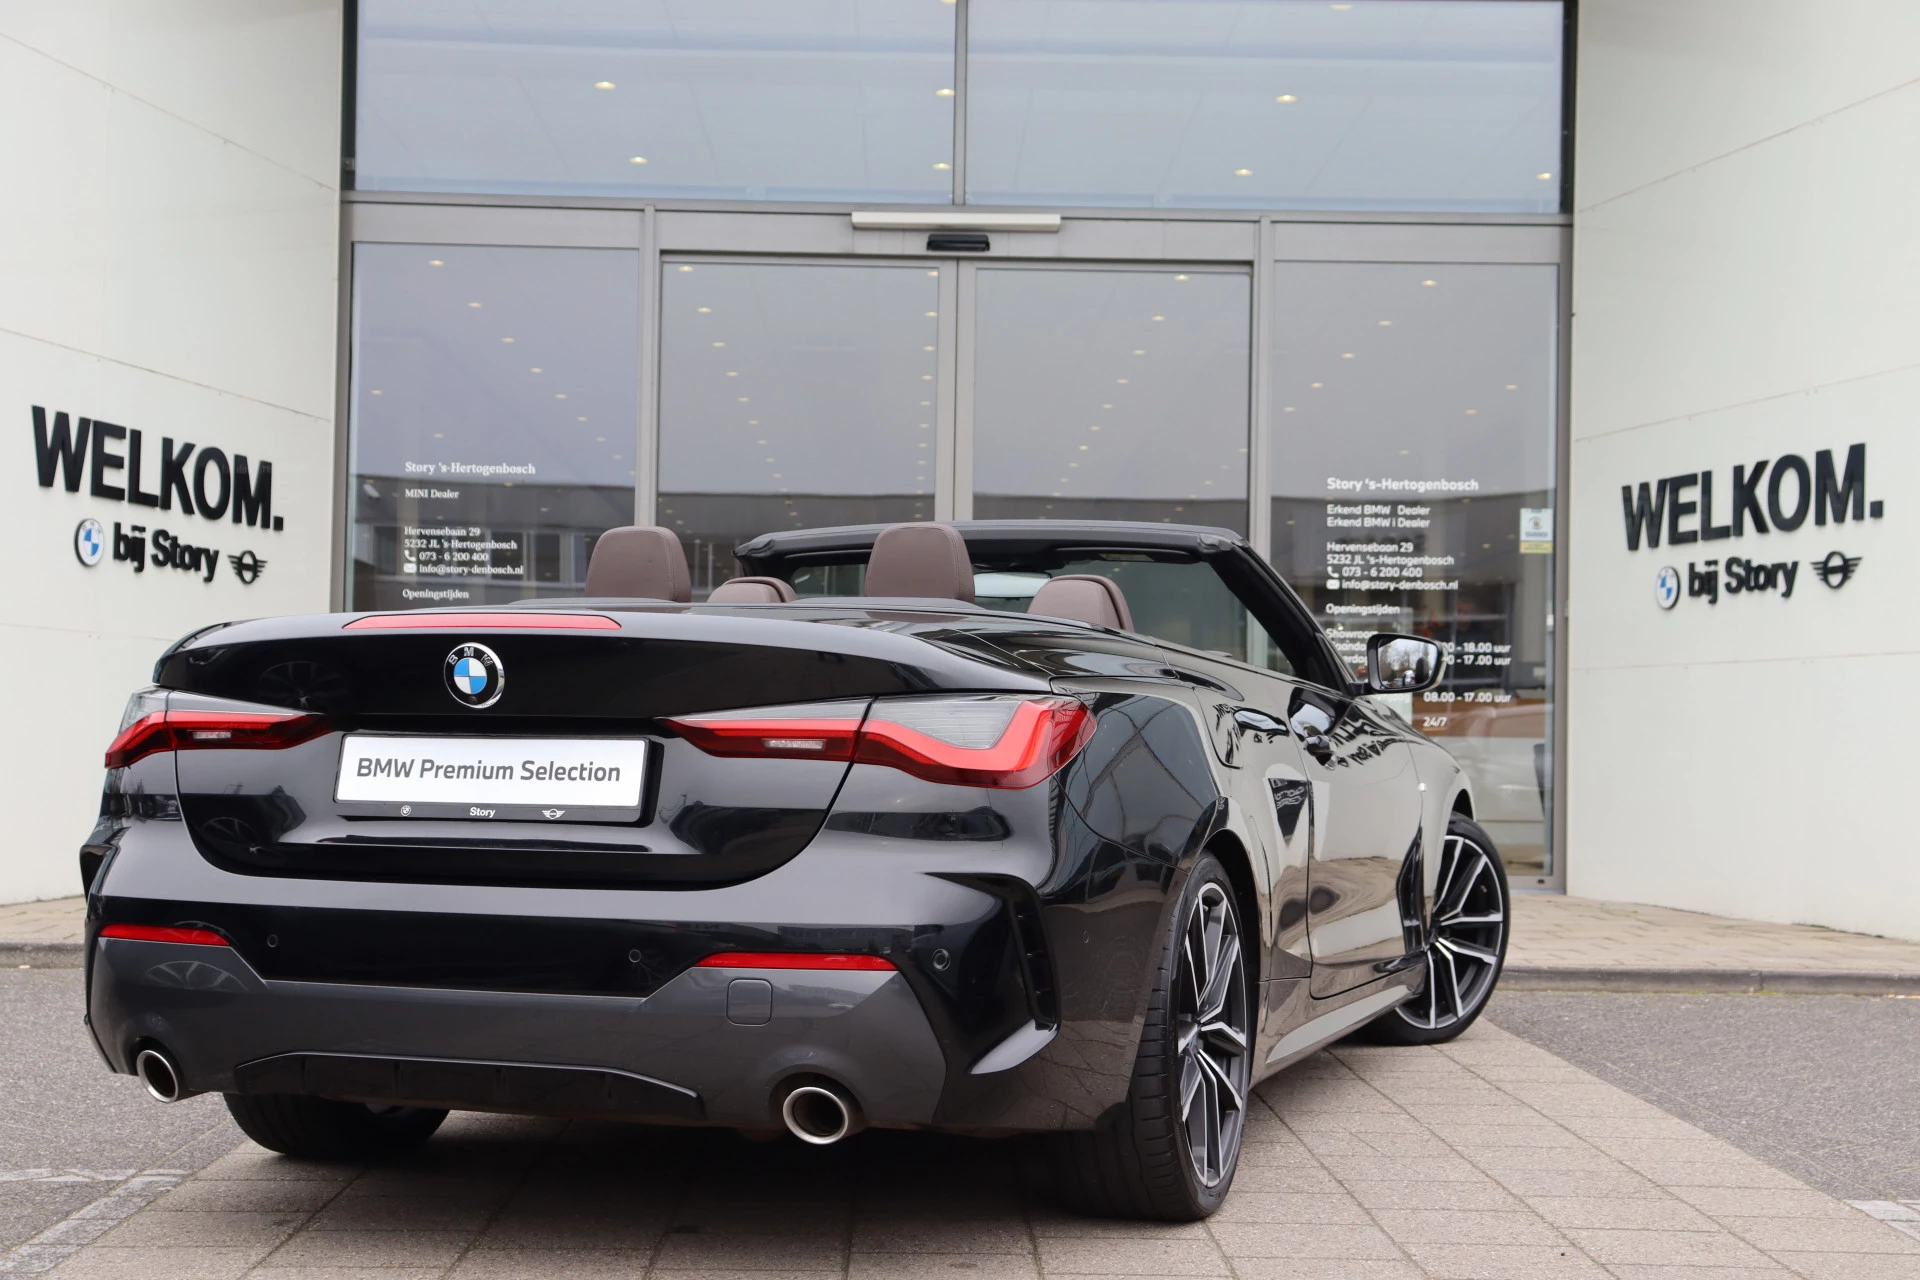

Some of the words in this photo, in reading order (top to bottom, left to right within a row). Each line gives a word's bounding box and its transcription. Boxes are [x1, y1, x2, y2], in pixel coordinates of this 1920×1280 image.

[31, 404, 284, 532] WELKOM.
[405, 462, 436, 476] Story
[1327, 478, 1363, 492] Story
[405, 489, 428, 498] MINI
[430, 489, 460, 499] Dealer
[1621, 442, 1884, 552] WELKOM.
[1327, 505, 1361, 515] Erkend
[1364, 505, 1391, 515] BMW
[1397, 505, 1431, 515] Dealer
[1327, 517, 1361, 528] Erkend
[1364, 517, 1391, 528] BMW
[1397, 517, 1431, 528] Dealer
[404, 527, 467, 537] Hervensebaan
[468, 527, 481, 537] 29
[404, 539, 427, 549] 5232
[1327, 542, 1398, 553] Hervensebaan
[1400, 542, 1413, 552] 29
[113, 521, 146, 574] bij
[151, 528, 220, 583] Story
[419, 552, 436, 561] 073
[452, 552, 470, 561] 200
[471, 552, 489, 561] 400
[1327, 555, 1351, 565] 5232
[1353, 555, 1365, 565] JL
[419, 564, 524, 576] info@story-denbosch.nl
[1342, 567, 1361, 577] 073
[1379, 567, 1400, 577] 200
[1401, 567, 1423, 577] 400
[1342, 579, 1459, 591] info@story-denbosch.nl
[1688, 560, 1719, 605] bij
[1724, 556, 1799, 599] Story
[402, 588, 470, 600] Openingstijden
[1326, 604, 1401, 616] Openingstijden
[1463, 642, 1492, 653] 18.00
[1493, 644, 1512, 653] uur
[448, 646, 494, 667] BMW
[1493, 657, 1512, 666] uur
[1423, 692, 1455, 703] 08.00
[1493, 694, 1512, 703] uur
[1423, 717, 1447, 727] 24/7
[356, 757, 414, 778] BMW
[419, 758, 514, 781] Premium
[520, 759, 621, 782] Selection
[469, 806, 496, 819] Story
